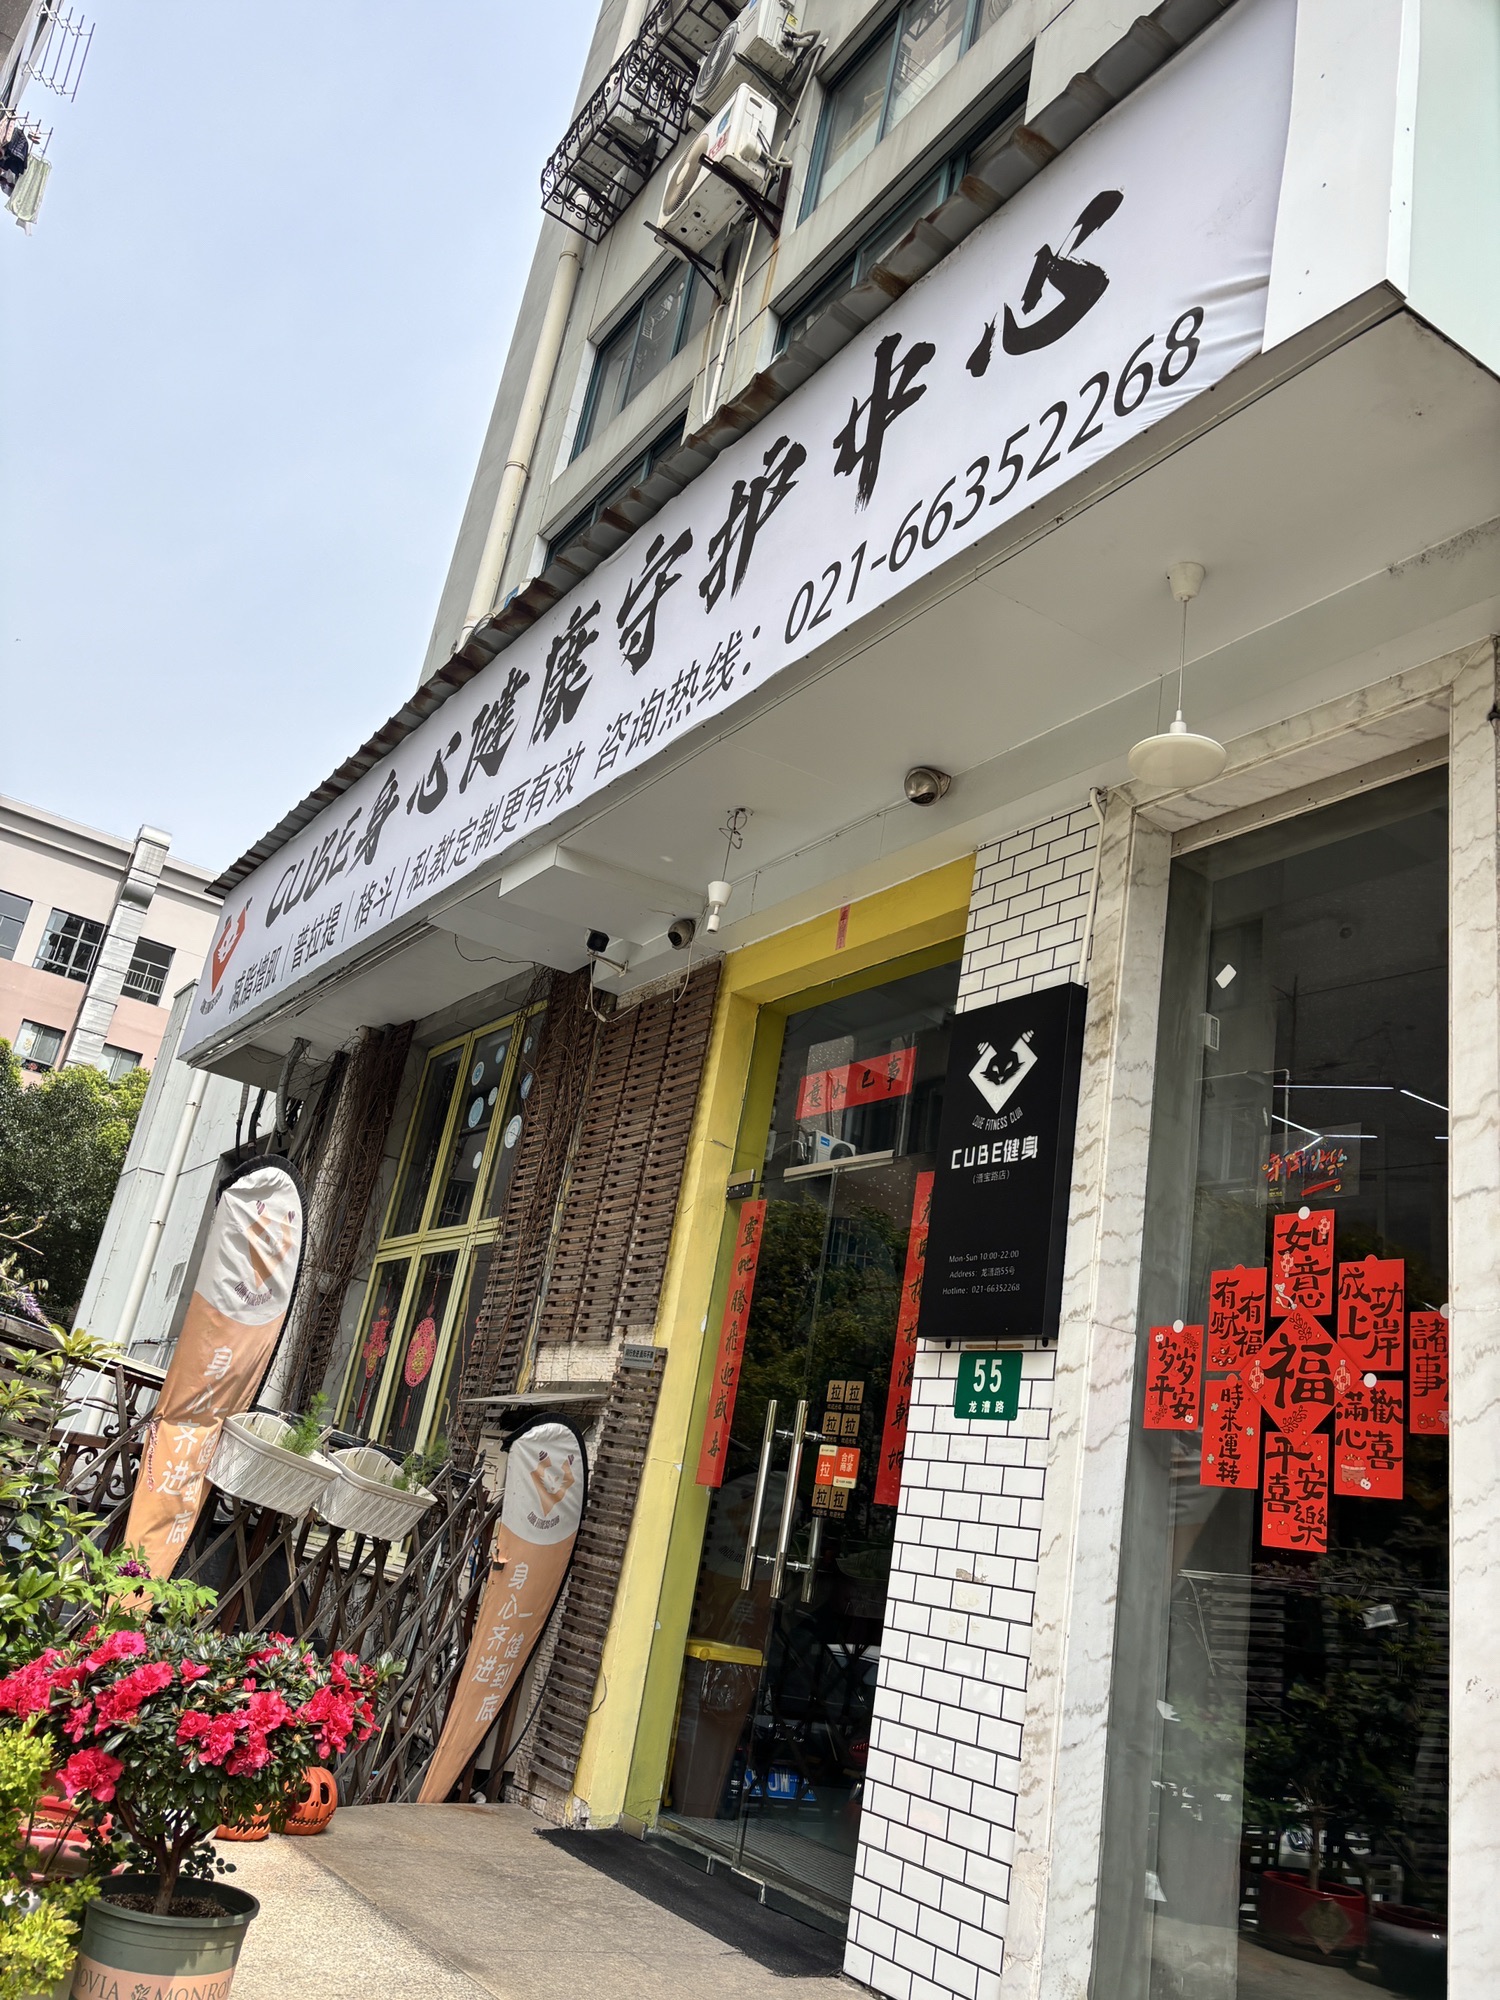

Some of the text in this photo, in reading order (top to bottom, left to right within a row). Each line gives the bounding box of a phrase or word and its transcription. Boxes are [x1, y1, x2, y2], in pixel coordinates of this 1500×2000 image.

[783, 306, 1205, 646] 021-66352268
[984, 1115, 1008, 1131] FITNESS
[1009, 1106, 1024, 1124] CLUB
[1276, 1220, 1332, 1309] 如意
[971, 1283, 1021, 1294] 021-66352268
[972, 1359, 1003, 1393] 55
[1263, 1332, 1336, 1409] 福
[831, 1384, 843, 1400] 拉
[849, 1385, 861, 1401] 拉
[968, 1400, 1005, 1413] 龙漕路
[826, 1416, 838, 1432] 拉
[845, 1418, 857, 1434] 拉
[820, 1461, 831, 1477] 拉
[816, 1489, 828, 1506] 拉
[833, 1491, 845, 1508] 拉
